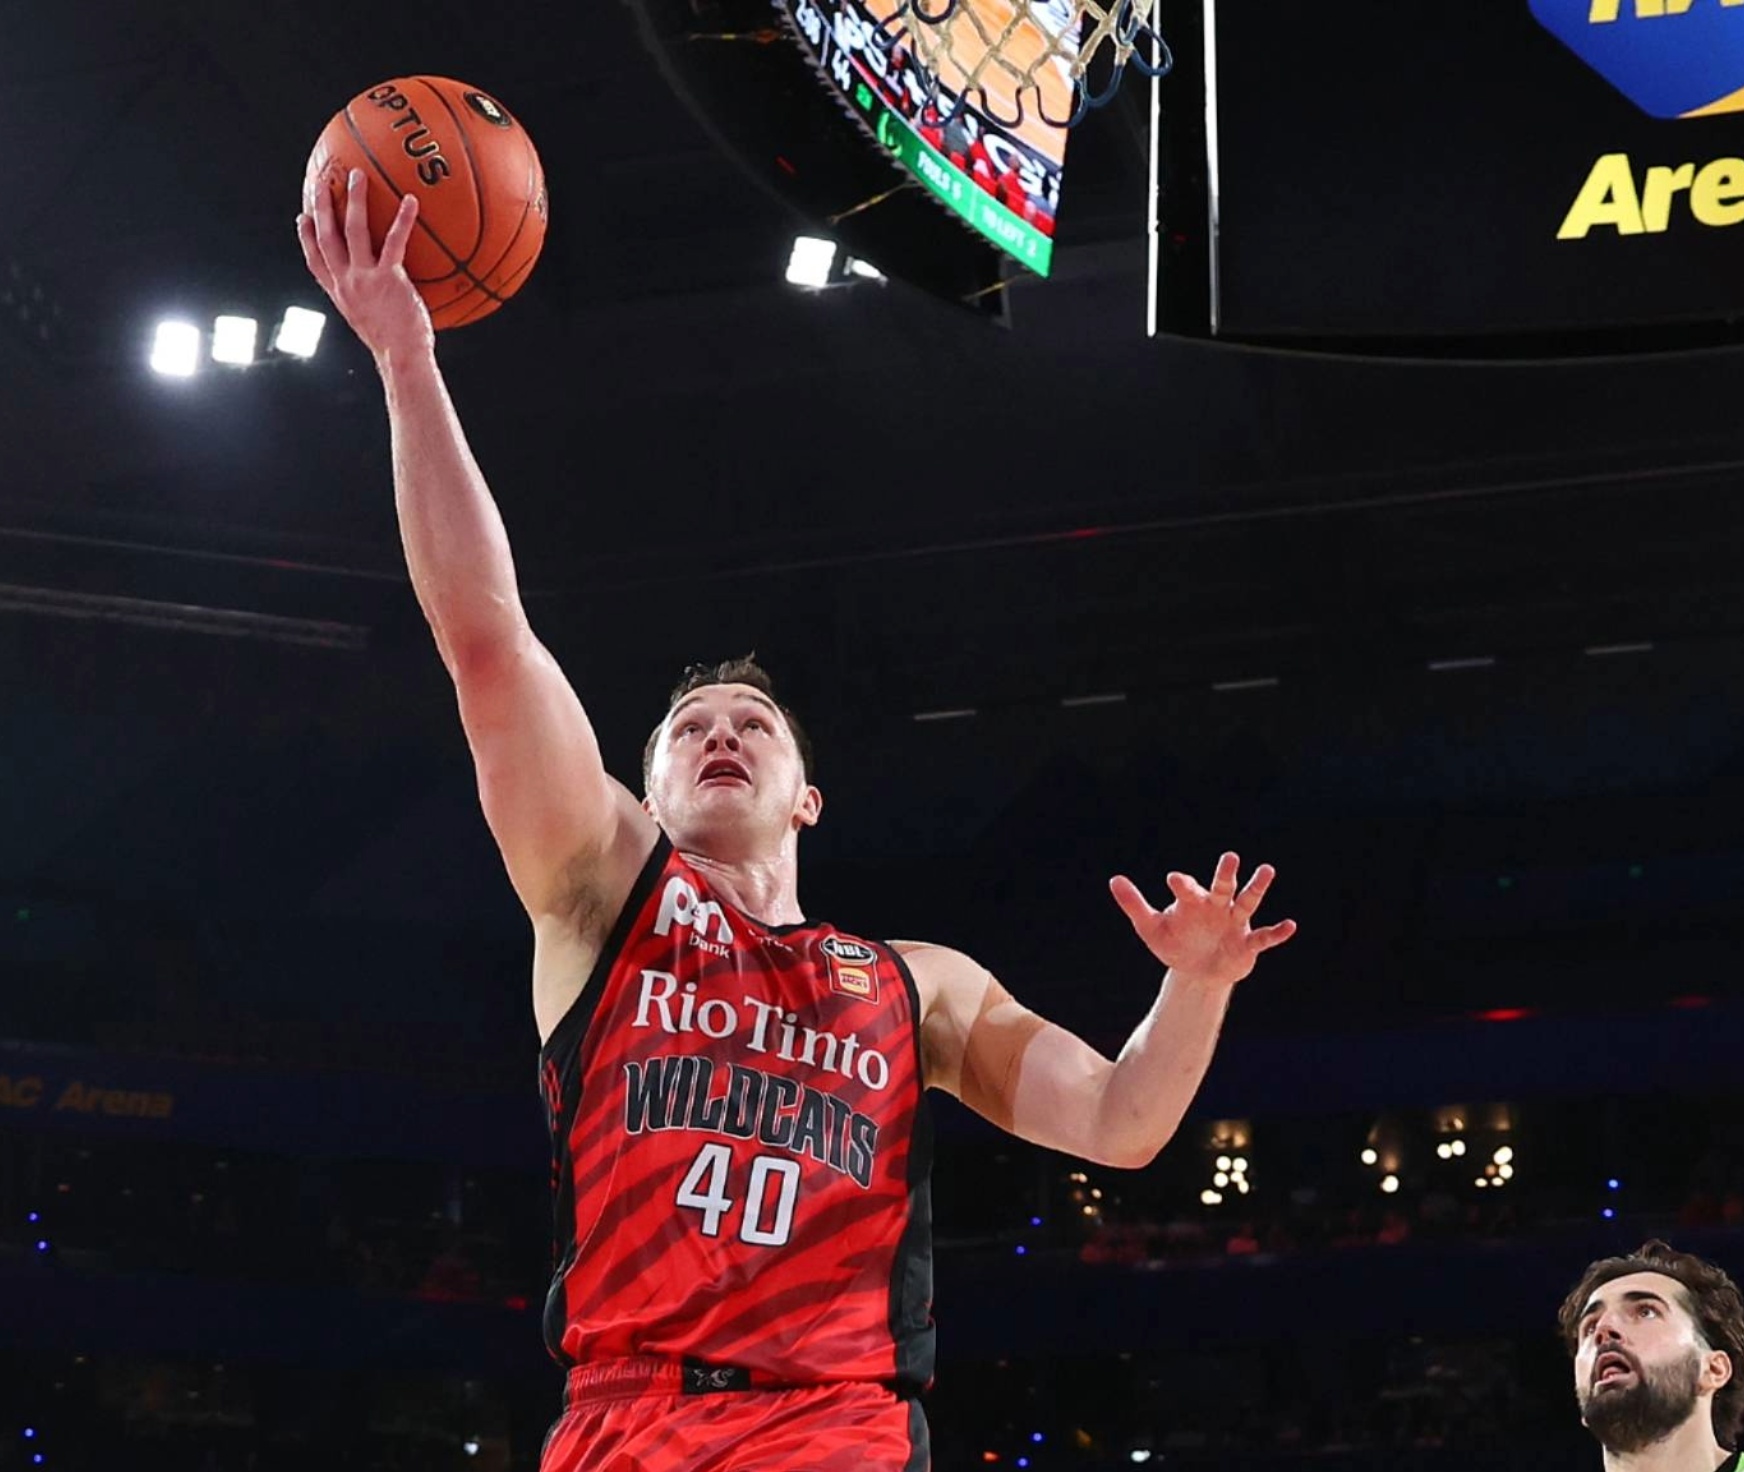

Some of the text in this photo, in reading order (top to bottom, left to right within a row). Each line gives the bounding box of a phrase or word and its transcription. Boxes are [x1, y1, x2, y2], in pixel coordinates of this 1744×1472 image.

[368, 85, 451, 187] OPTUS
[688, 932, 731, 960] bank
[56, 1081, 173, 1118] Arena
[623, 1055, 881, 1190] WILDCATS
[676, 1142, 802, 1247] 40
